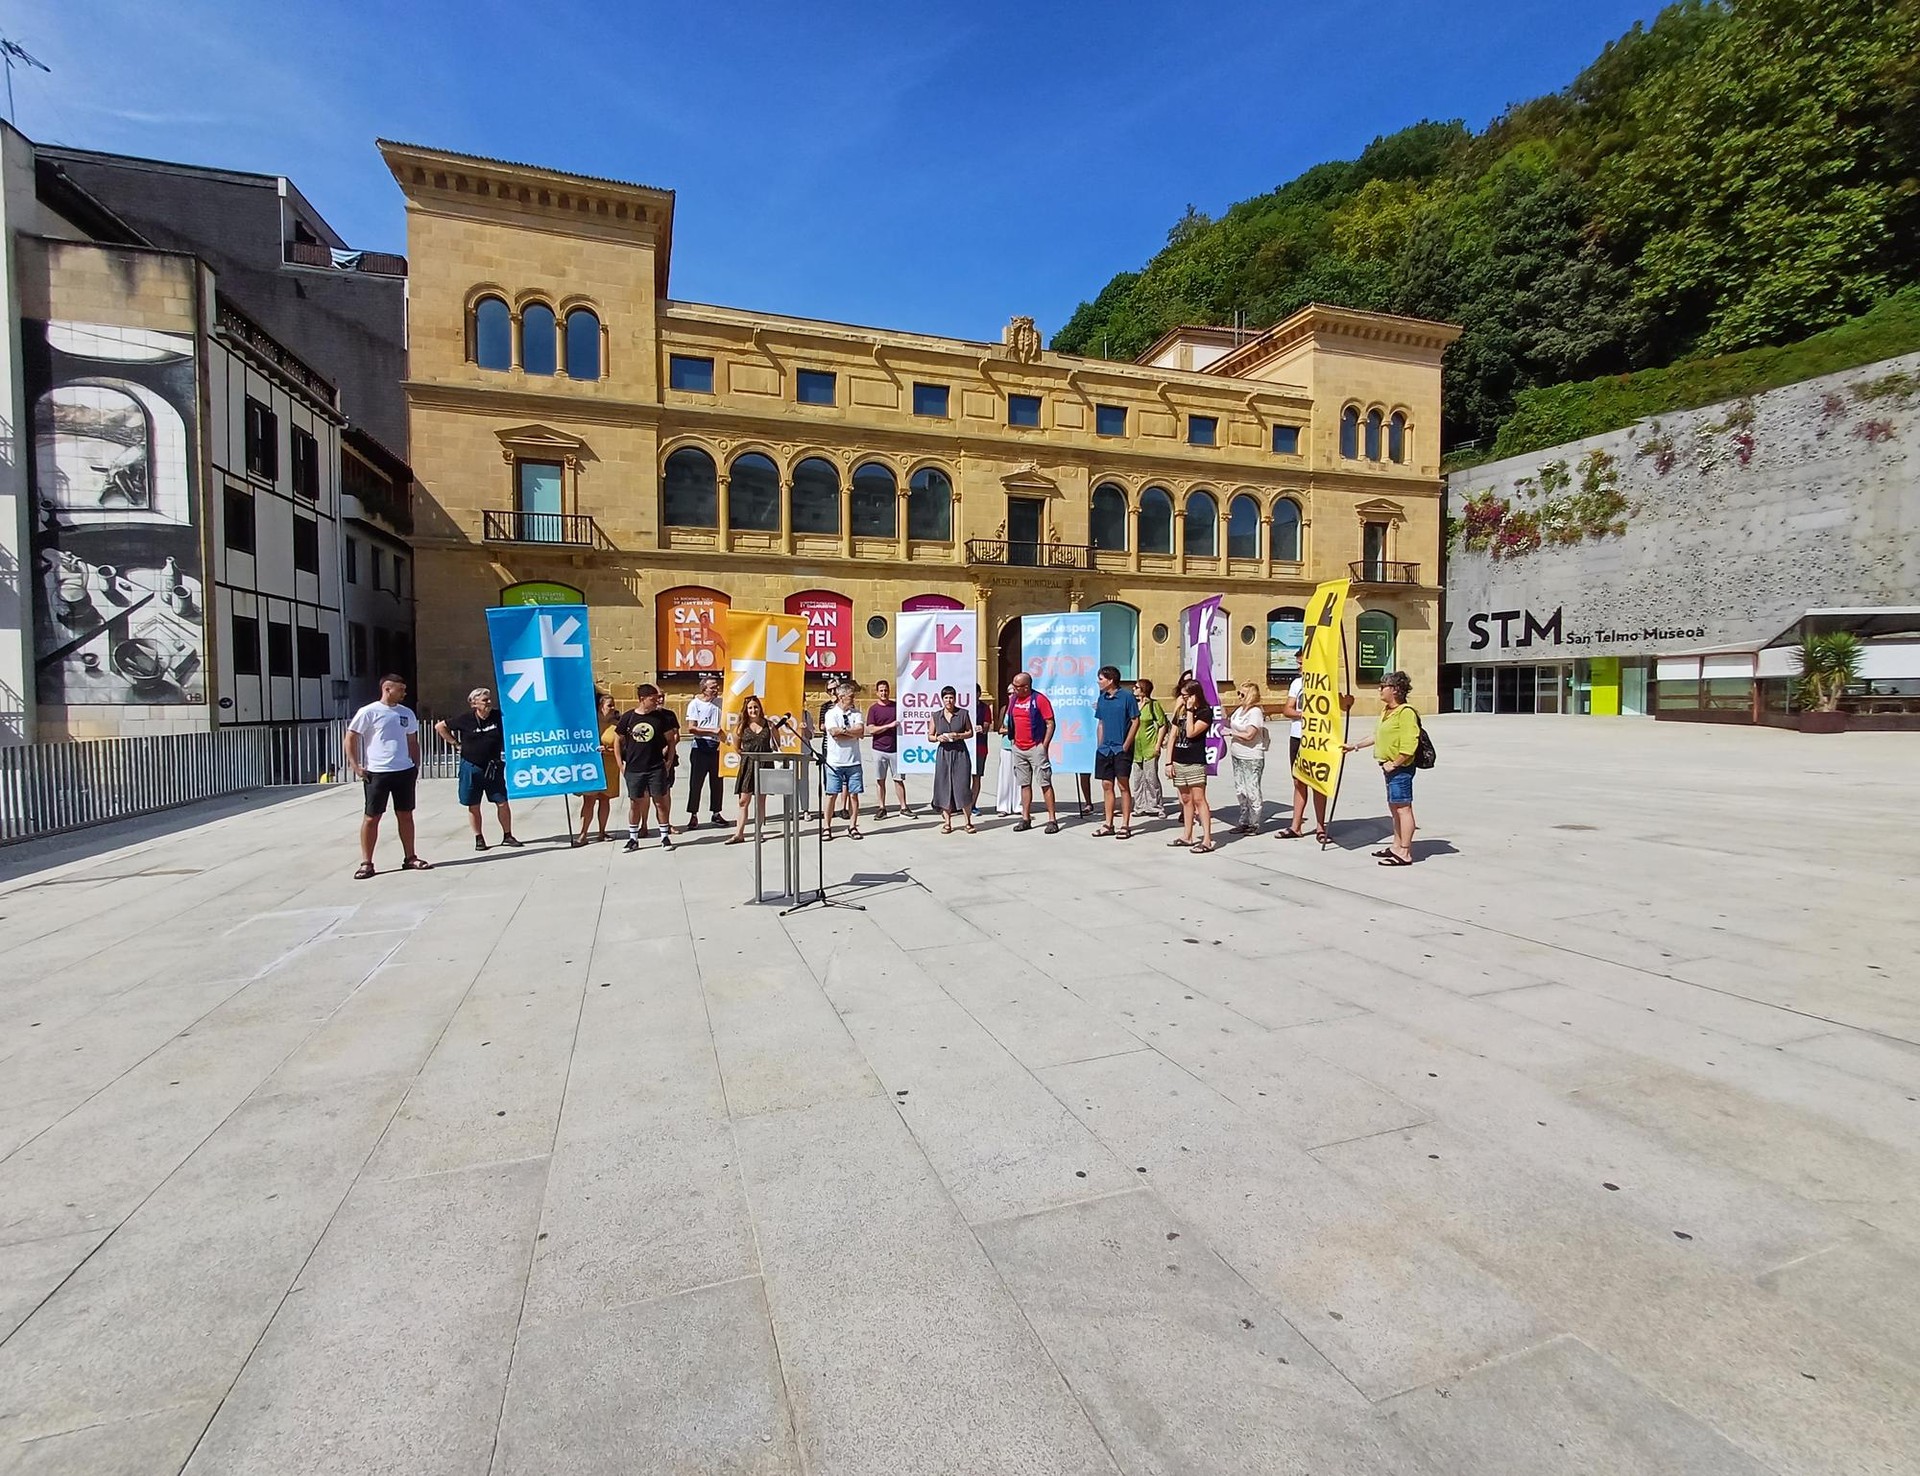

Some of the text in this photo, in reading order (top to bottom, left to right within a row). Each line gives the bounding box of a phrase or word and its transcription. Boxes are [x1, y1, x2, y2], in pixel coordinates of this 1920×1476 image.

[674, 608, 714, 624] SAN
[675, 627, 714, 645] TEL
[1468, 606, 1562, 650] STM
[1566, 627, 1705, 644] San Telmo Museoa
[675, 649, 714, 667] MO
[1028, 656, 1095, 678] STOP
[902, 693, 970, 708] GRAU
[510, 729, 593, 746] IHESLARI eta
[512, 743, 595, 760] DEPORTATUAK
[903, 745, 936, 764] etx
[514, 763, 598, 788] etxera
